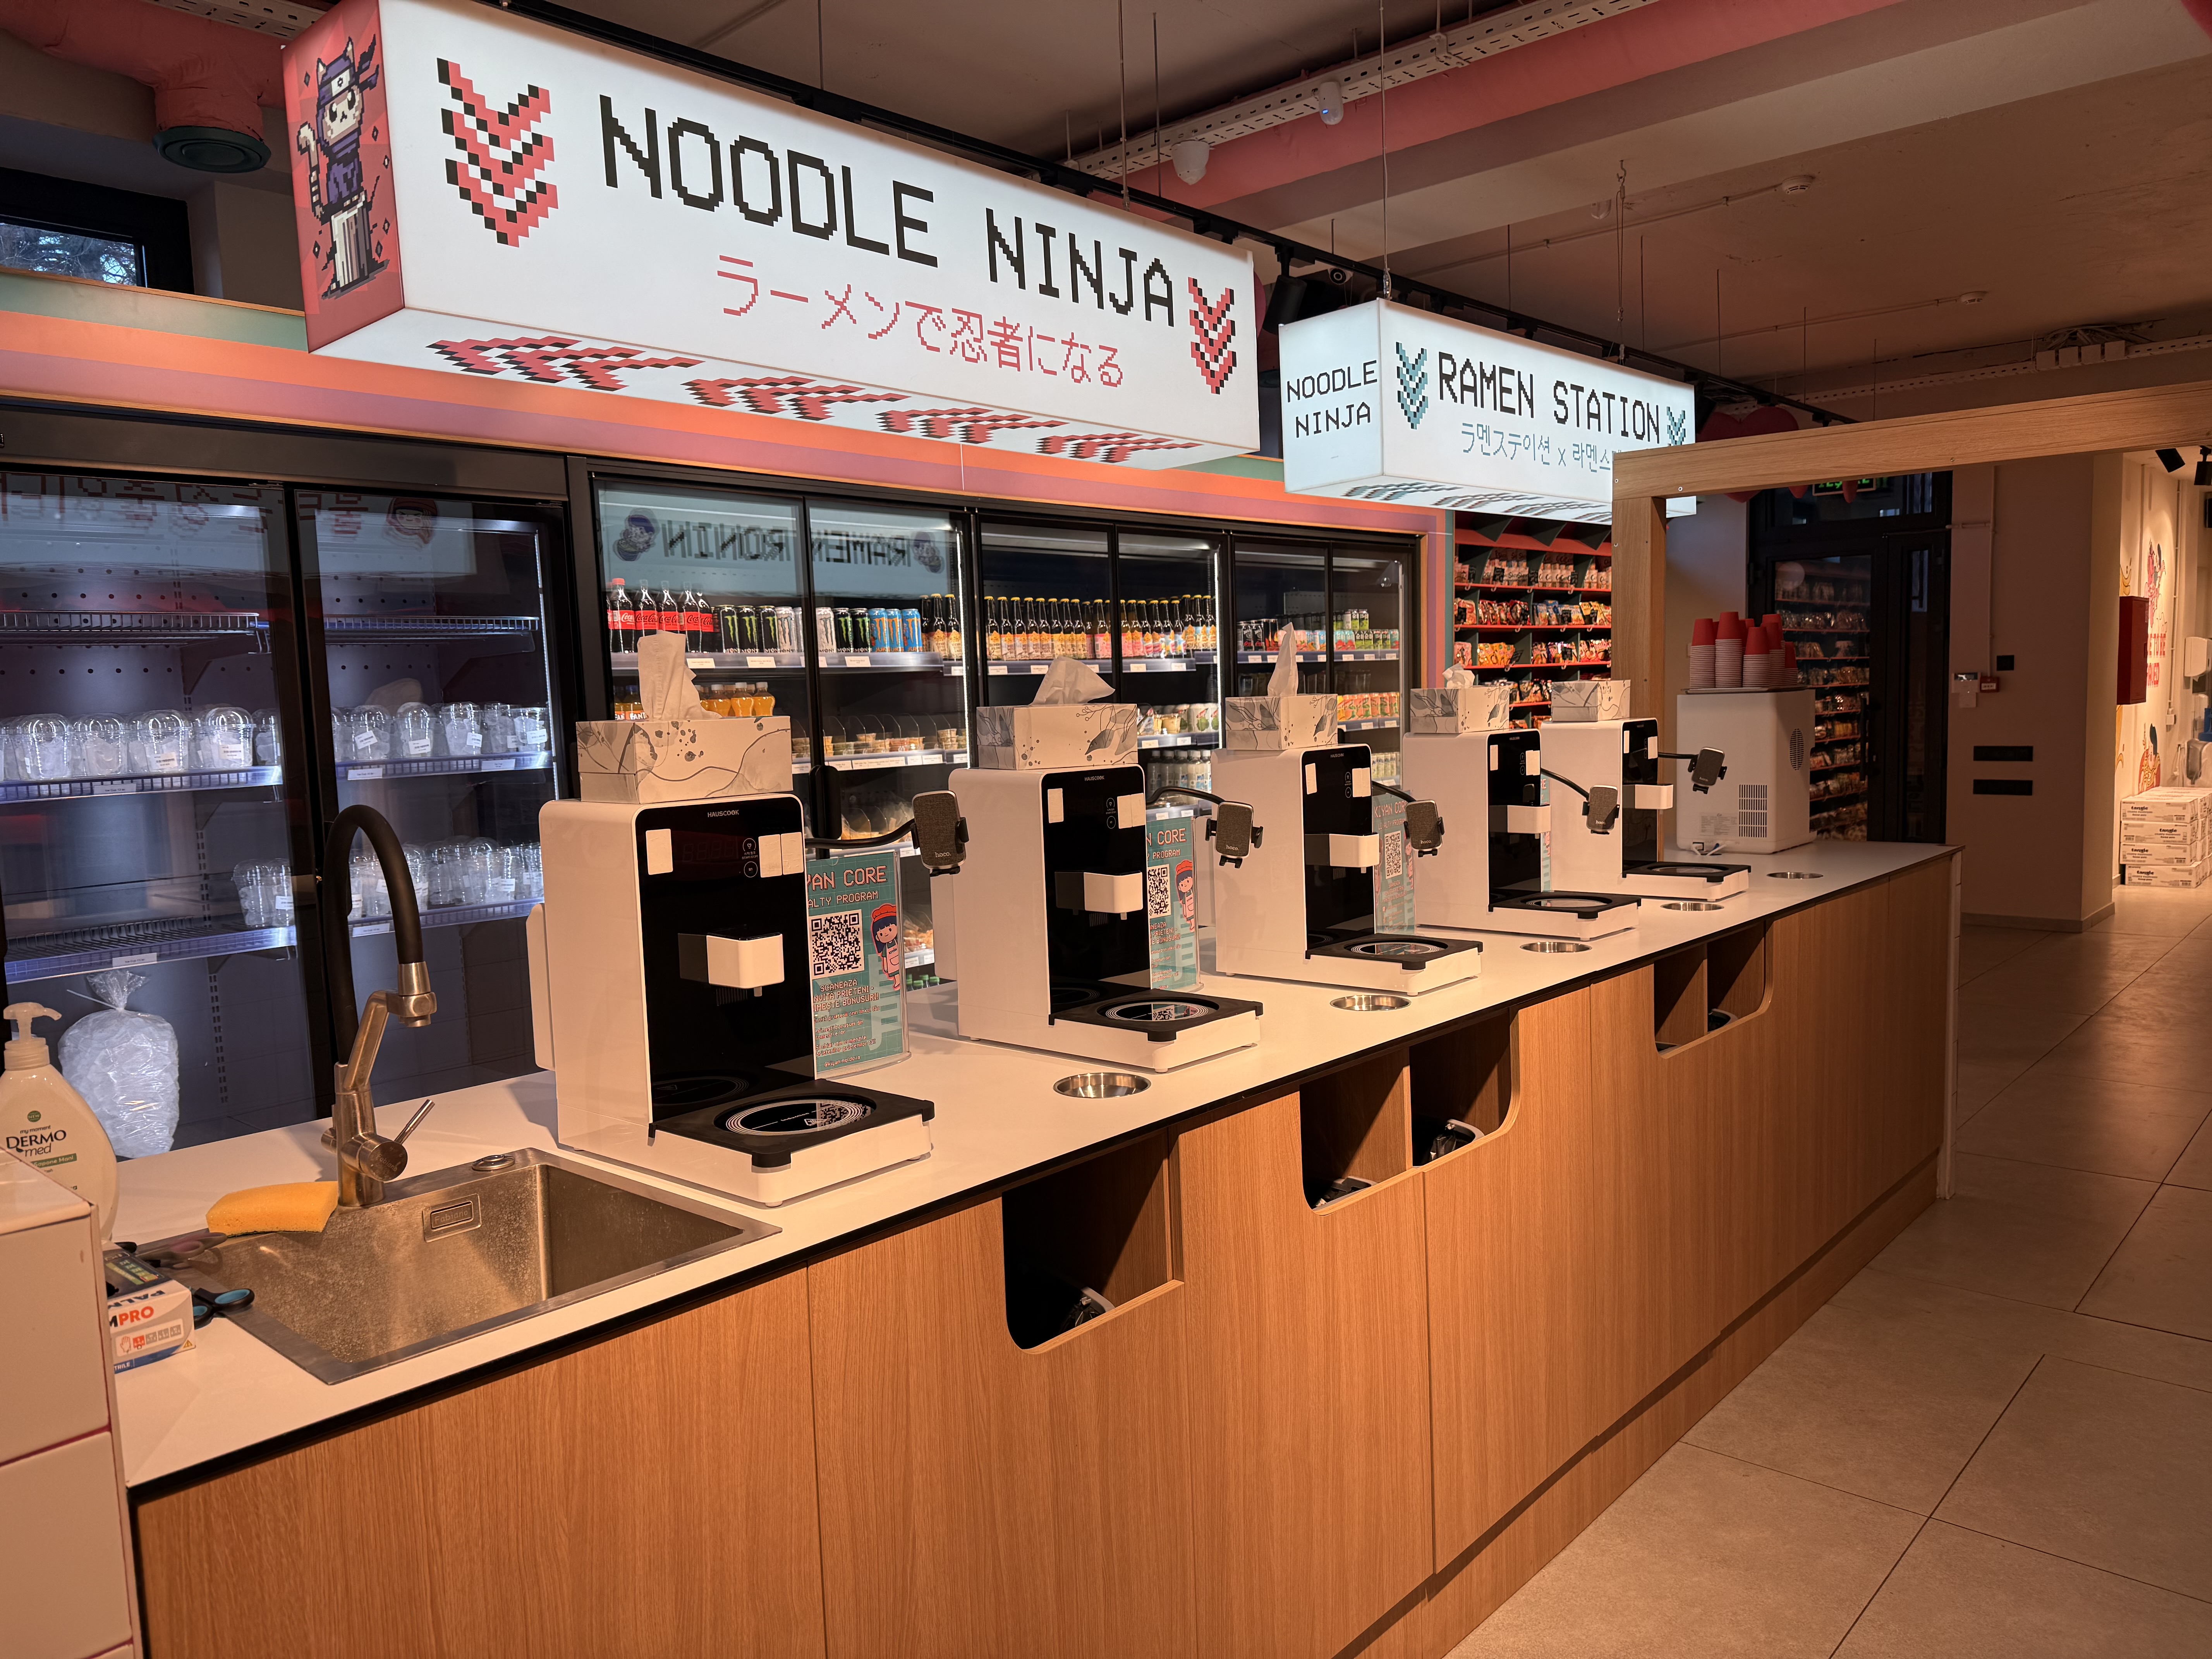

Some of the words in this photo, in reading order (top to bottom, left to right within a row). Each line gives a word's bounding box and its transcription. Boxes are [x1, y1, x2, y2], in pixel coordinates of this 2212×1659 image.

[599, 94, 938, 268] NOODLE
[986, 208, 1174, 327] NINJA
[717, 255, 1123, 387] ラーメンで忍者になる
[1287, 360, 1377, 403] NOODLE
[1439, 351, 1534, 418] RAMEN
[1553, 380, 1659, 444] STATION
[1296, 402, 1370, 438] NINJA
[1572, 442, 1621, 472] 라멘스
[707, 809, 739, 817] HAUSCOOK
[1374, 803, 1393, 818] KIYAN
[1158, 828, 1186, 845] CORE
[1152, 848, 1180, 860] PROGRAM
[843, 865, 888, 887] CORE
[836, 890, 879, 904] PROGRAM
[1152, 927, 1174, 937] PRIETENI
[836, 985, 869, 999] PRIETENI
[6, 1130, 67, 1149] DERMO
[25, 1142, 52, 1157] med
